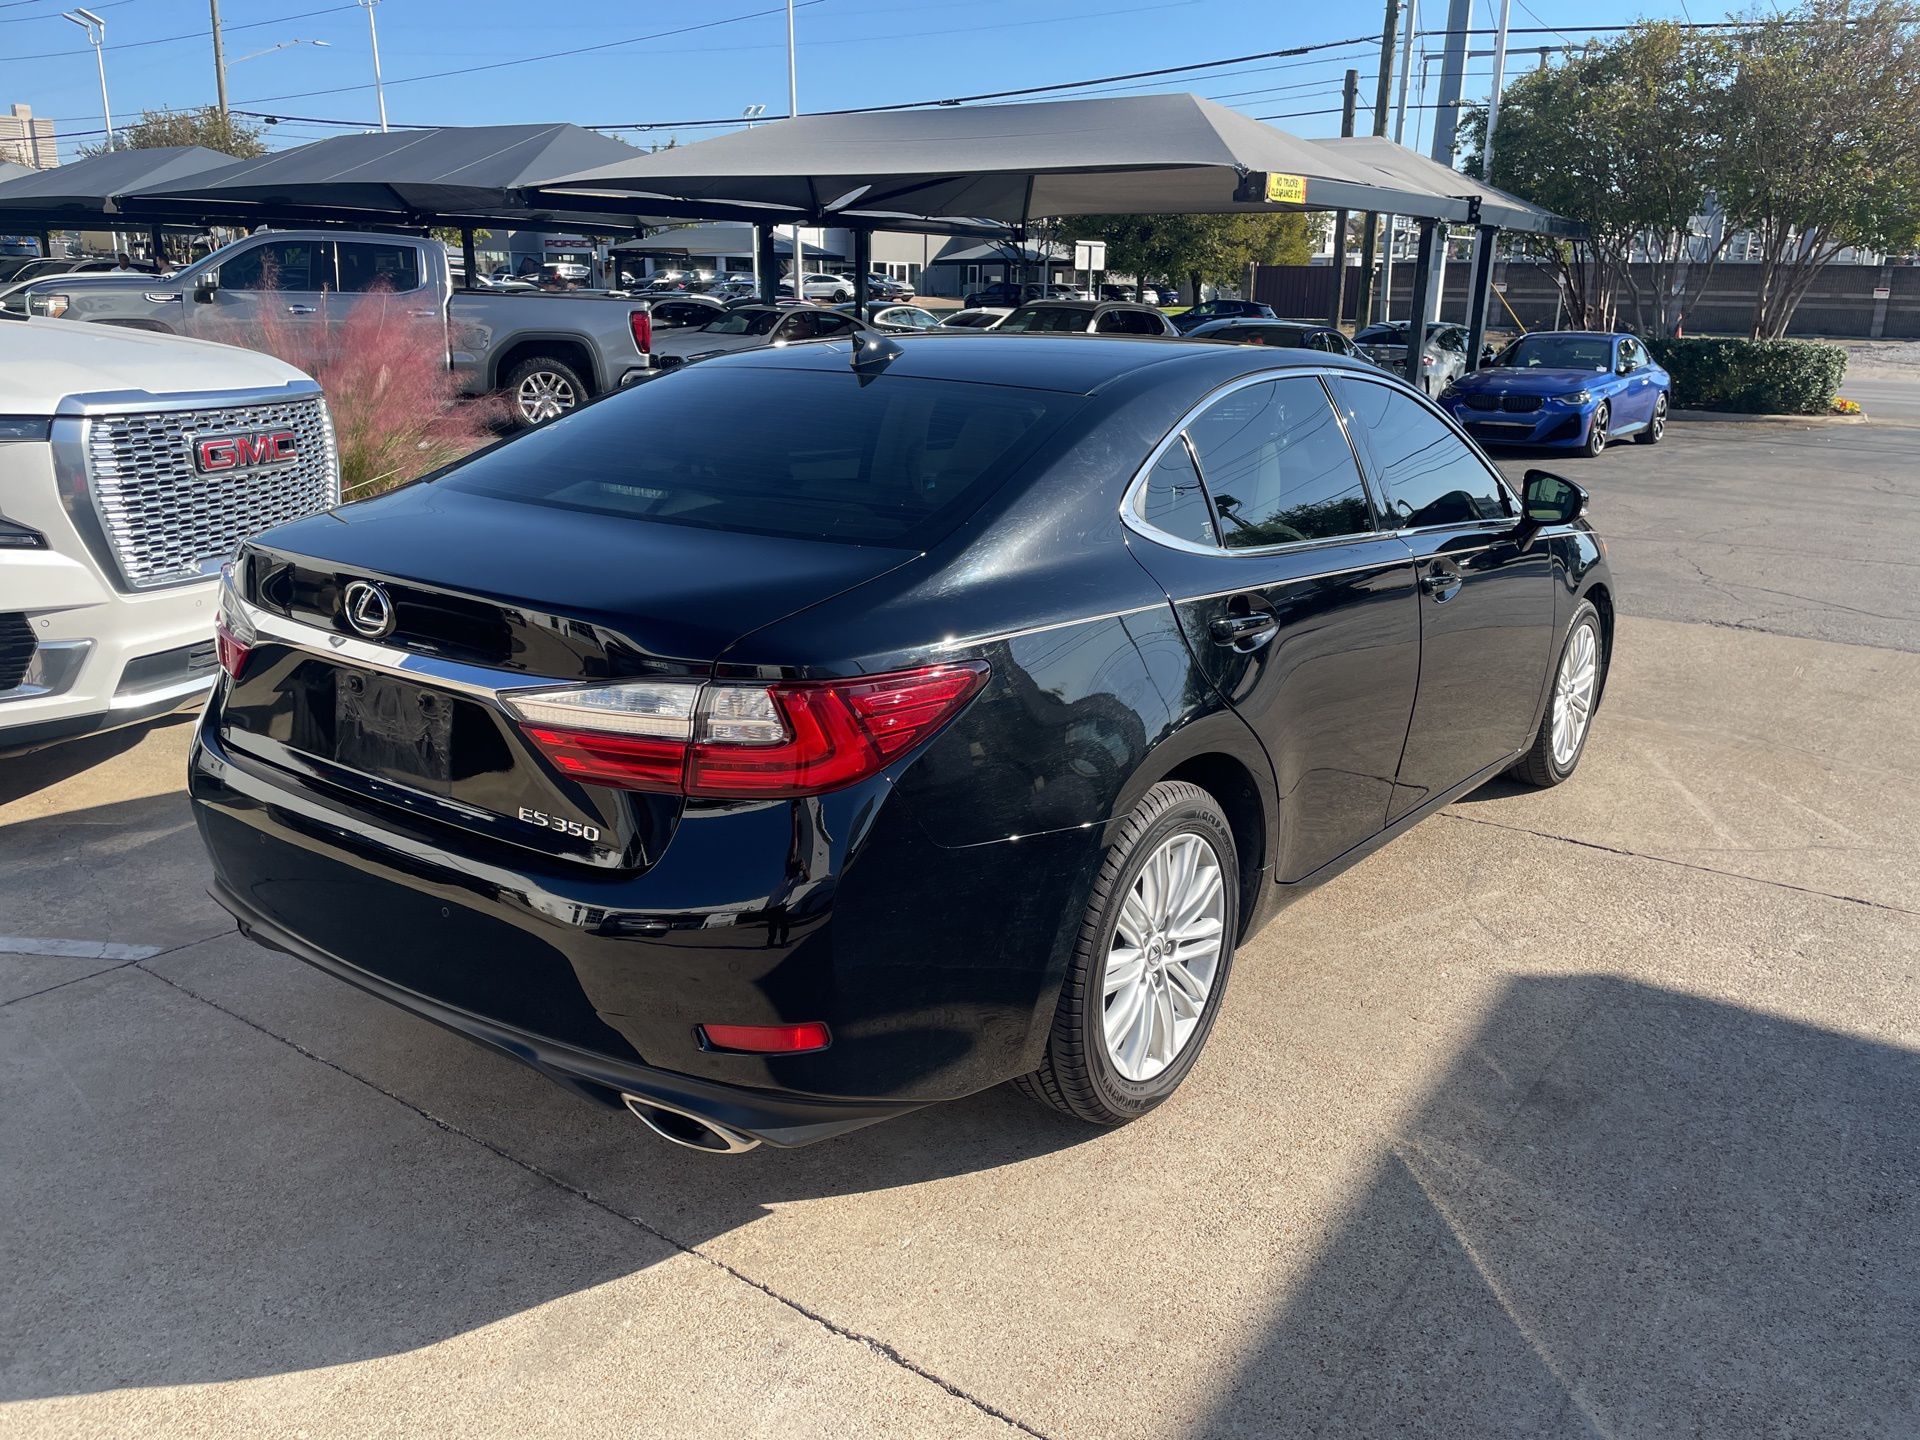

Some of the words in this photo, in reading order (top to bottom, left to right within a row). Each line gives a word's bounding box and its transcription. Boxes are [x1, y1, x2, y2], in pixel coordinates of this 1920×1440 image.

[1276, 177, 1283, 187] NO
[200, 432, 298, 471] GMC
[518, 806, 549, 827] ES
[552, 816, 600, 841] 350
